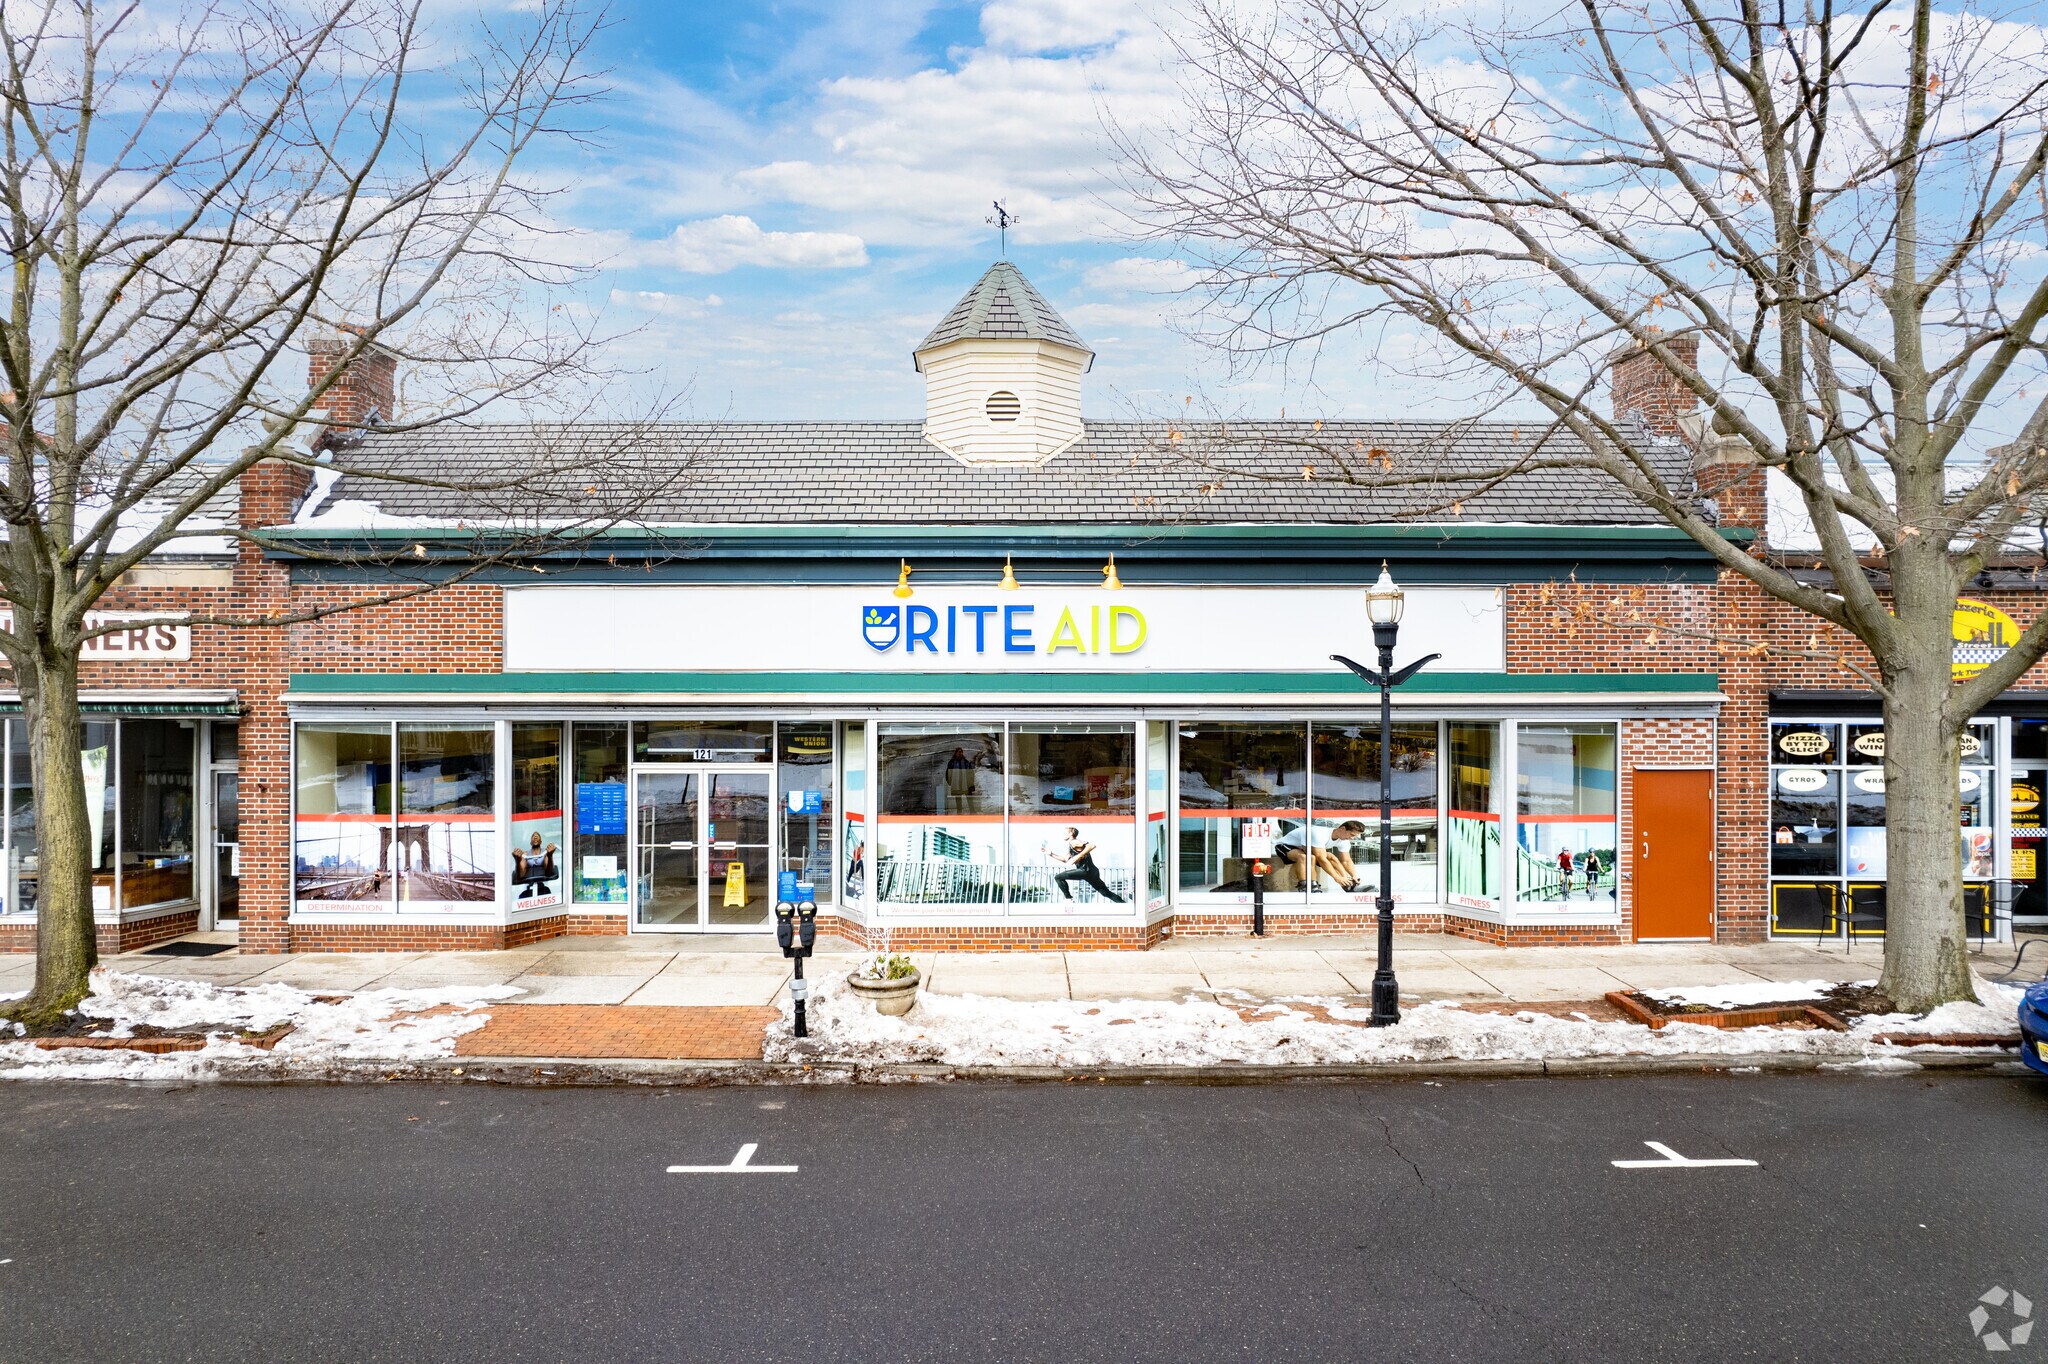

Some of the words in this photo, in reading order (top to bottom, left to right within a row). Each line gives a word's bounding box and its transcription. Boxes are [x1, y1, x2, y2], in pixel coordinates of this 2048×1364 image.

[1955, 601, 1994, 619] izzeria
[906, 605, 1036, 652] RITE
[1046, 605, 1147, 653] AID
[694, 749, 711, 759] 121
[307, 903, 383, 912] DETERMINATION
[517, 896, 556, 909] WELLNESS
[1459, 896, 1491, 909] FITNESS
